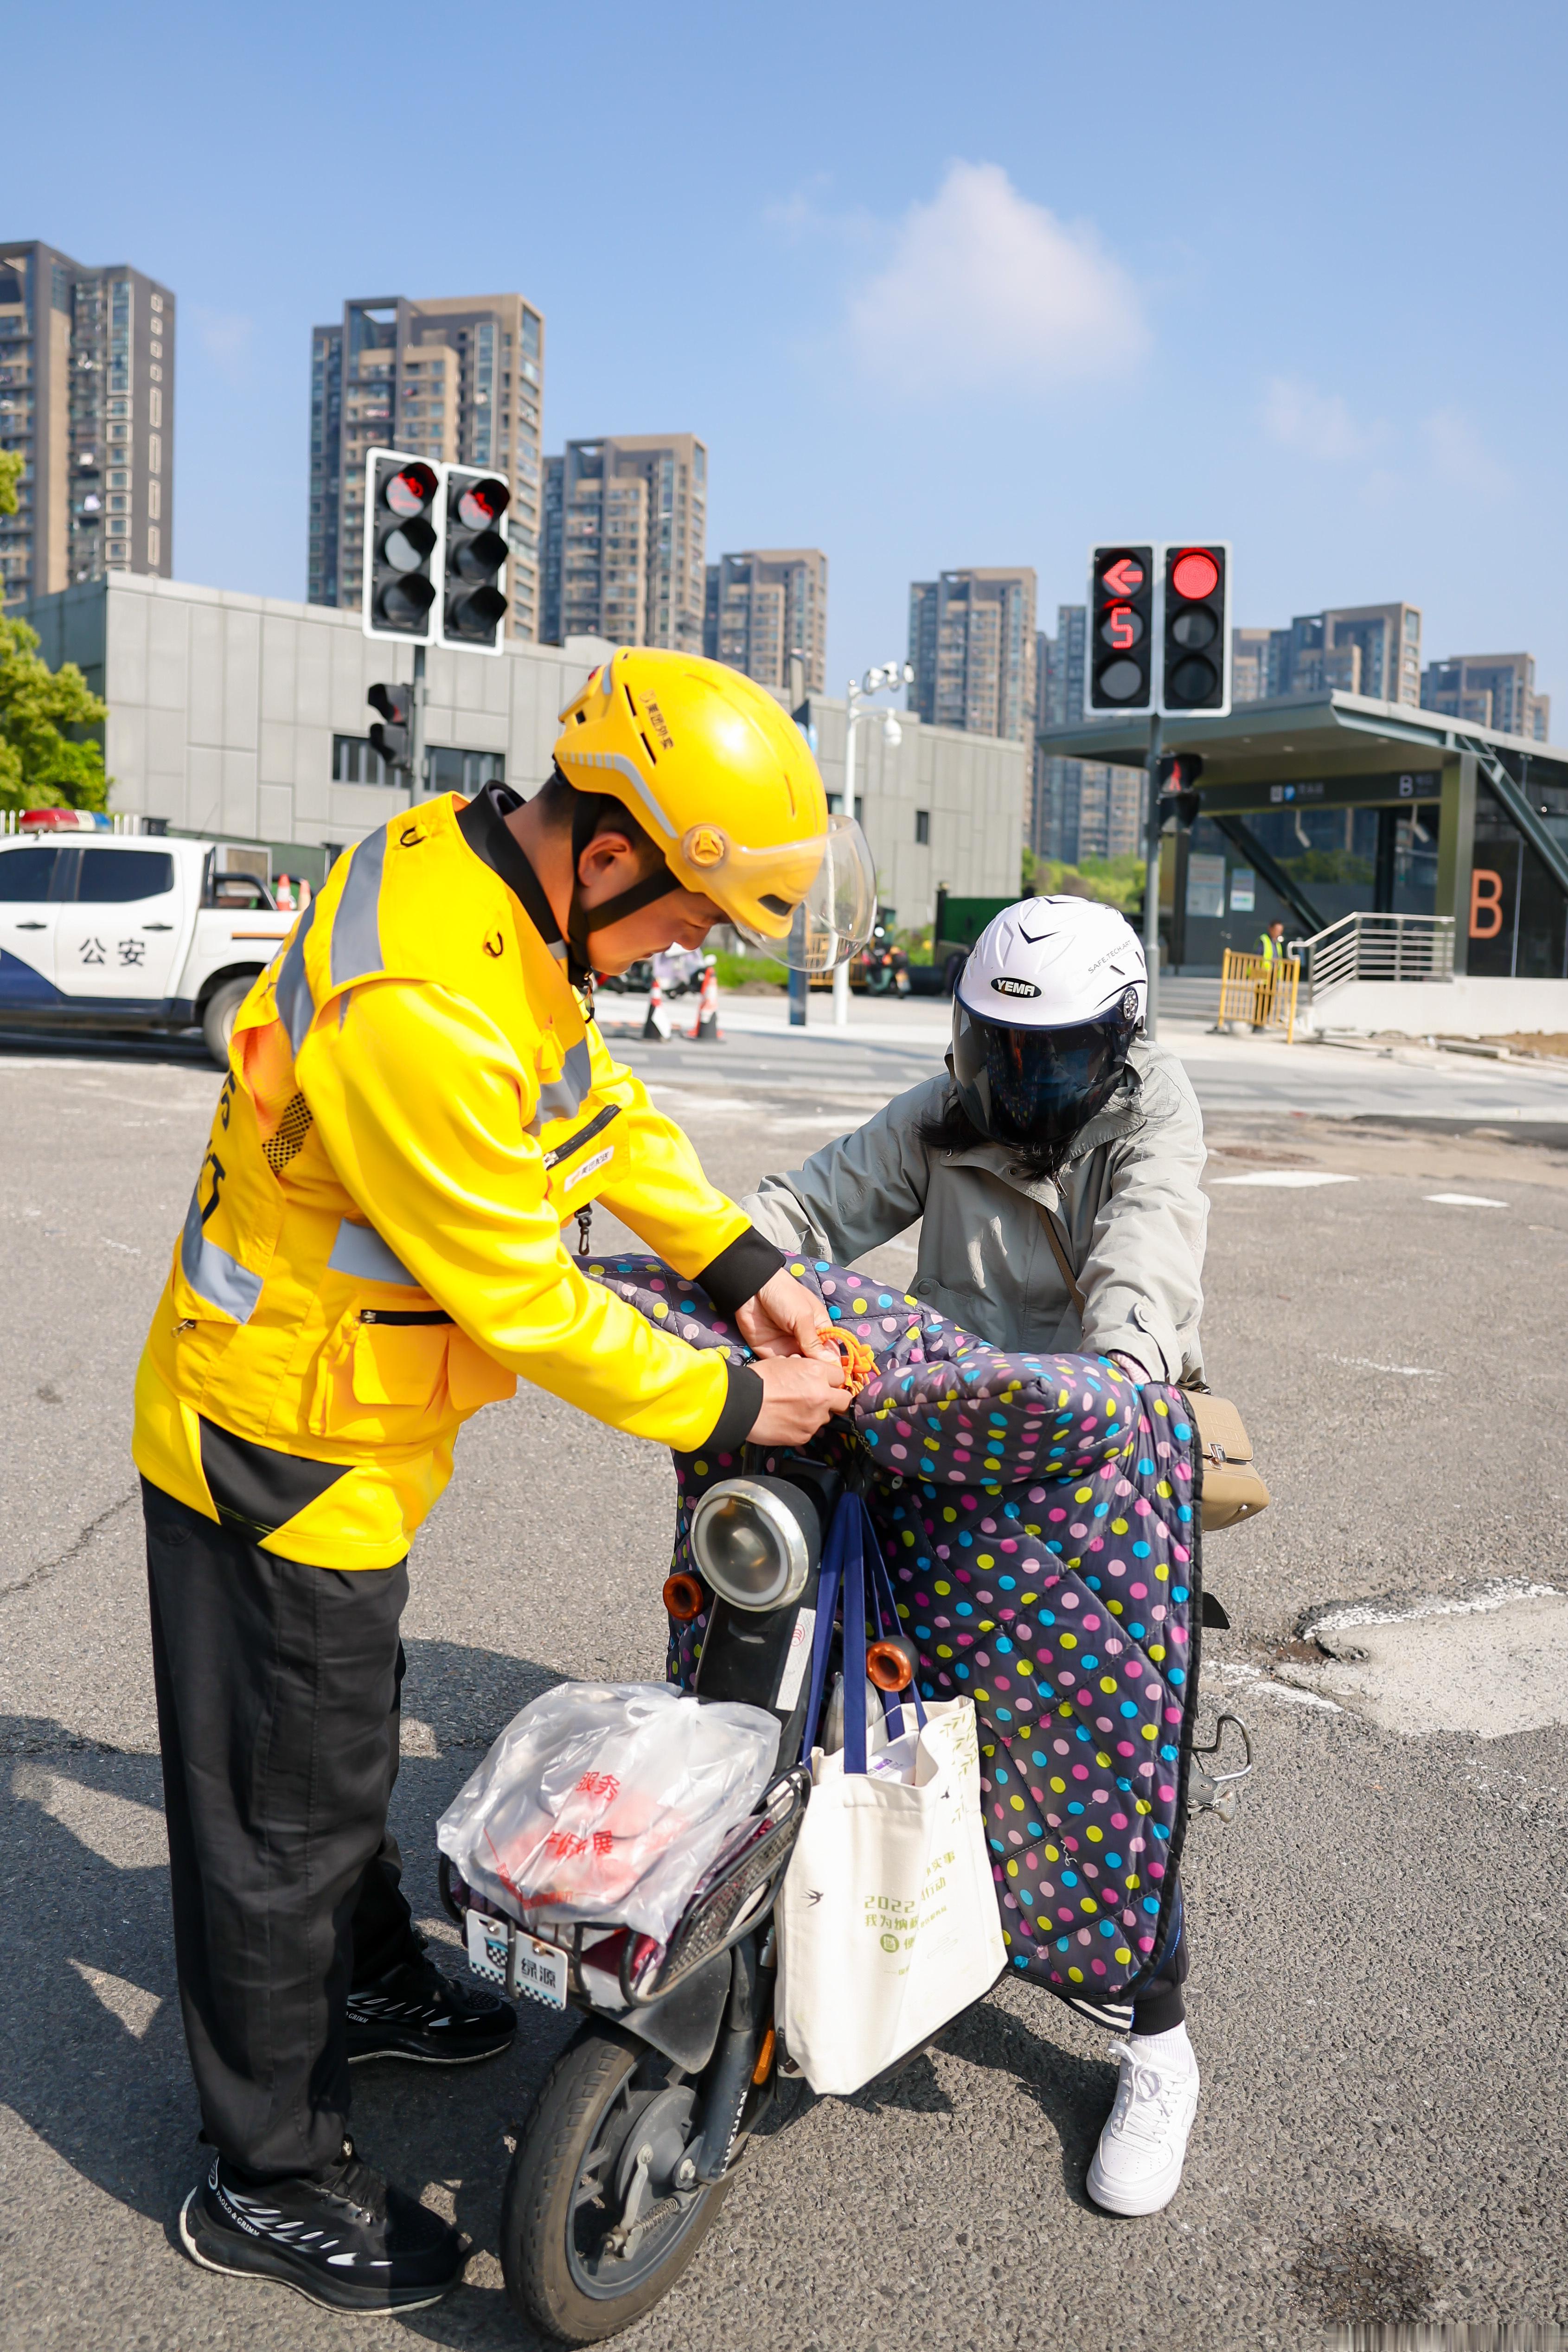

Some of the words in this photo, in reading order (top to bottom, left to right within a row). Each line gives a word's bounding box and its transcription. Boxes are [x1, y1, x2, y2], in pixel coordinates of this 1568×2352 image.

[1111, 607, 1133, 648] 5
[645, 703, 674, 750] 美团外卖
[1399, 775, 1413, 797] B
[1469, 869, 1503, 939] B
[79, 938, 145, 966] 公安
[997, 979, 1035, 996] YEMA
[576, 1771, 621, 1801] 服务
[864, 1896, 915, 1913] 2022
[521, 1958, 556, 1989] 绿源
[216, 2190, 232, 2214] PAOLO
[231, 2211, 237, 2220] &
[237, 2216, 260, 2237] GRIMM
